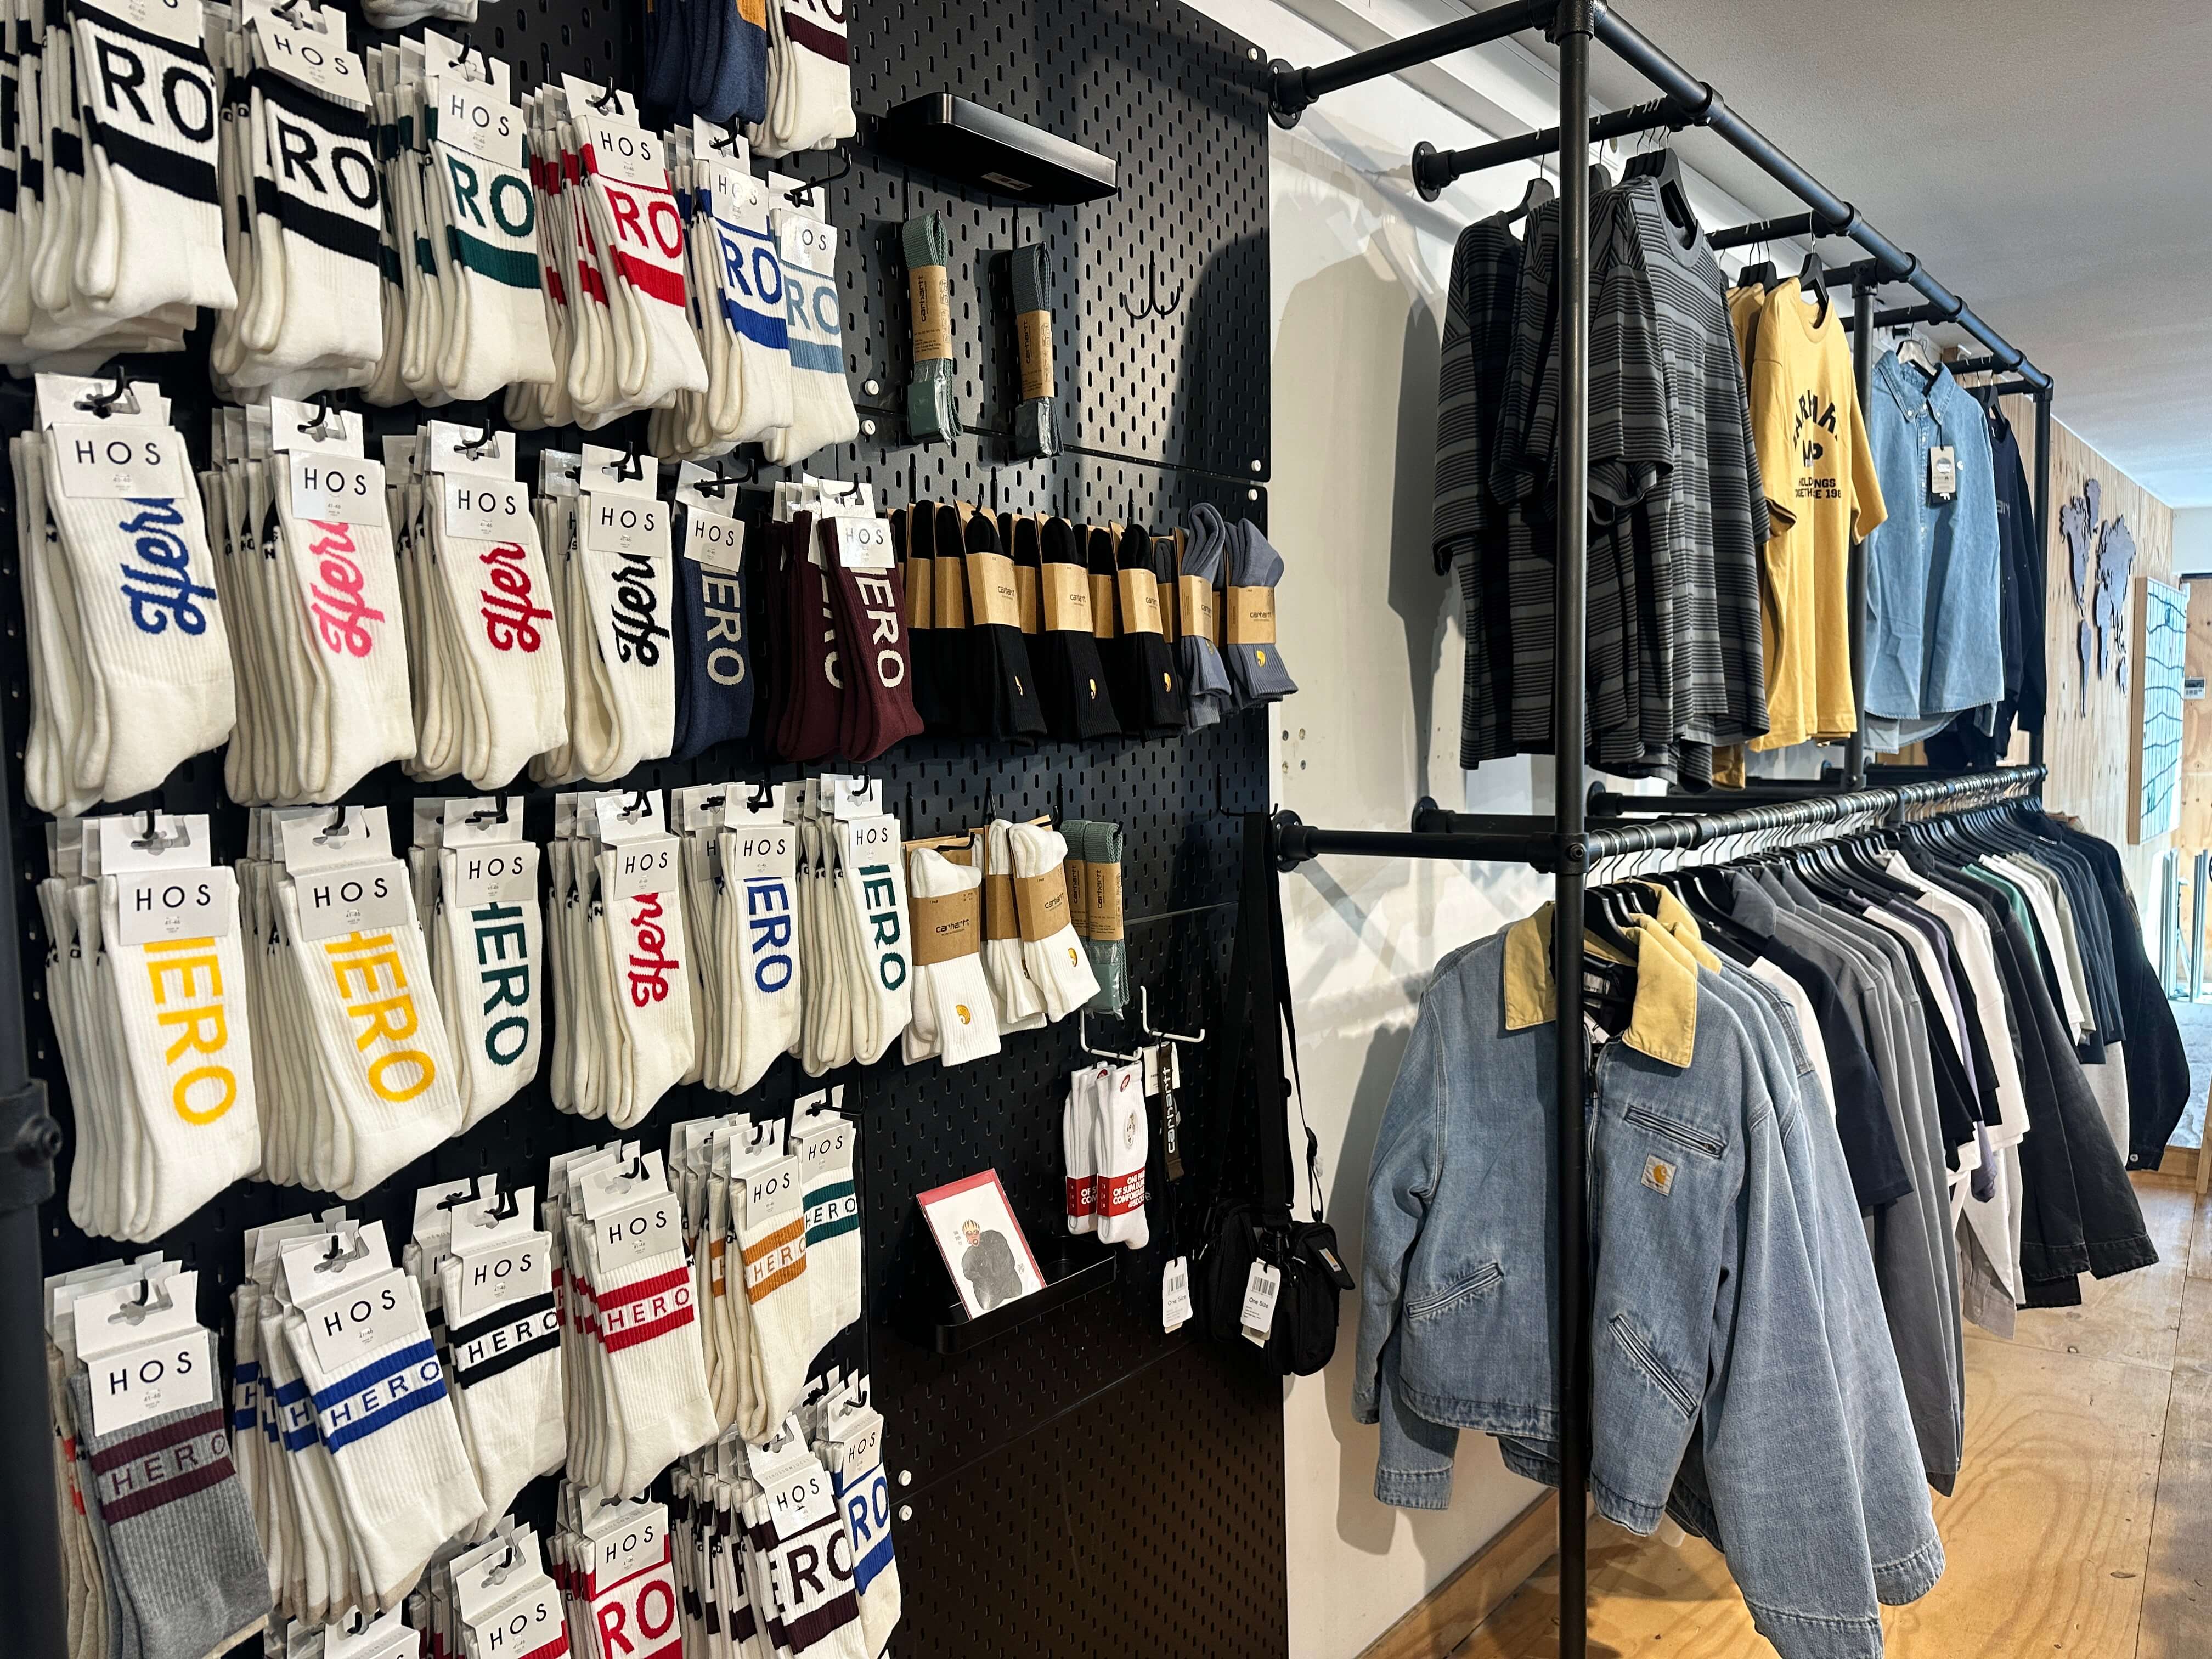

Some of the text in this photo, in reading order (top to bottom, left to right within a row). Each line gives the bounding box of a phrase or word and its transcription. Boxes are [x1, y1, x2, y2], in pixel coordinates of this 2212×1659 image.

[274, 34, 348, 75] HOS
[452, 94, 509, 137] HOS
[600, 131, 651, 160] HOS
[802, 229, 826, 251] OS
[918, 275, 926, 322] carhartt
[75, 440, 161, 465] HOS
[304, 467, 366, 495] HOS
[458, 489, 516, 515] HOS
[601, 507, 654, 531] HOS
[695, 520, 734, 546] HOS
[845, 528, 883, 545] HOS
[699, 562, 745, 686] ERO
[849, 567, 904, 688] ERO
[743, 839, 786, 857] HOS
[856, 827, 888, 845] HOS
[469, 856, 523, 879] HOS
[625, 851, 668, 874] HOS
[136, 884, 211, 911] HOS
[313, 878, 388, 909] HOS
[743, 877, 793, 994] ERO
[936, 918, 969, 933] carhartt
[143, 936, 237, 1126] ERO
[1162, 1066, 1176, 1154] carhartt
[808, 1135, 843, 1161] HOS
[754, 1172, 790, 1203] HOS
[1081, 1188, 1091, 1197] OF
[1113, 1188, 1122, 1197] OF
[1122, 1183, 1135, 1194] SUPA
[1127, 1174, 1138, 1184] ONE
[609, 1211, 667, 1244] HOS
[805, 1198, 856, 1229] HERO
[475, 1254, 531, 1286] HOS
[753, 1236, 806, 1282] HERO
[324, 1289, 396, 1336] HOS
[608, 1287, 690, 1332] HERO
[1259, 1300, 1268, 1308] Size
[469, 1311, 558, 1364] HERO
[110, 1351, 192, 1395] HOS
[331, 1361, 441, 1427] HERO
[849, 1432, 876, 1463] HOS
[112, 1434, 225, 1497] HERO
[776, 1478, 820, 1511] HOS
[606, 1526, 653, 1564] HOS
[490, 1603, 546, 1651] HOS
